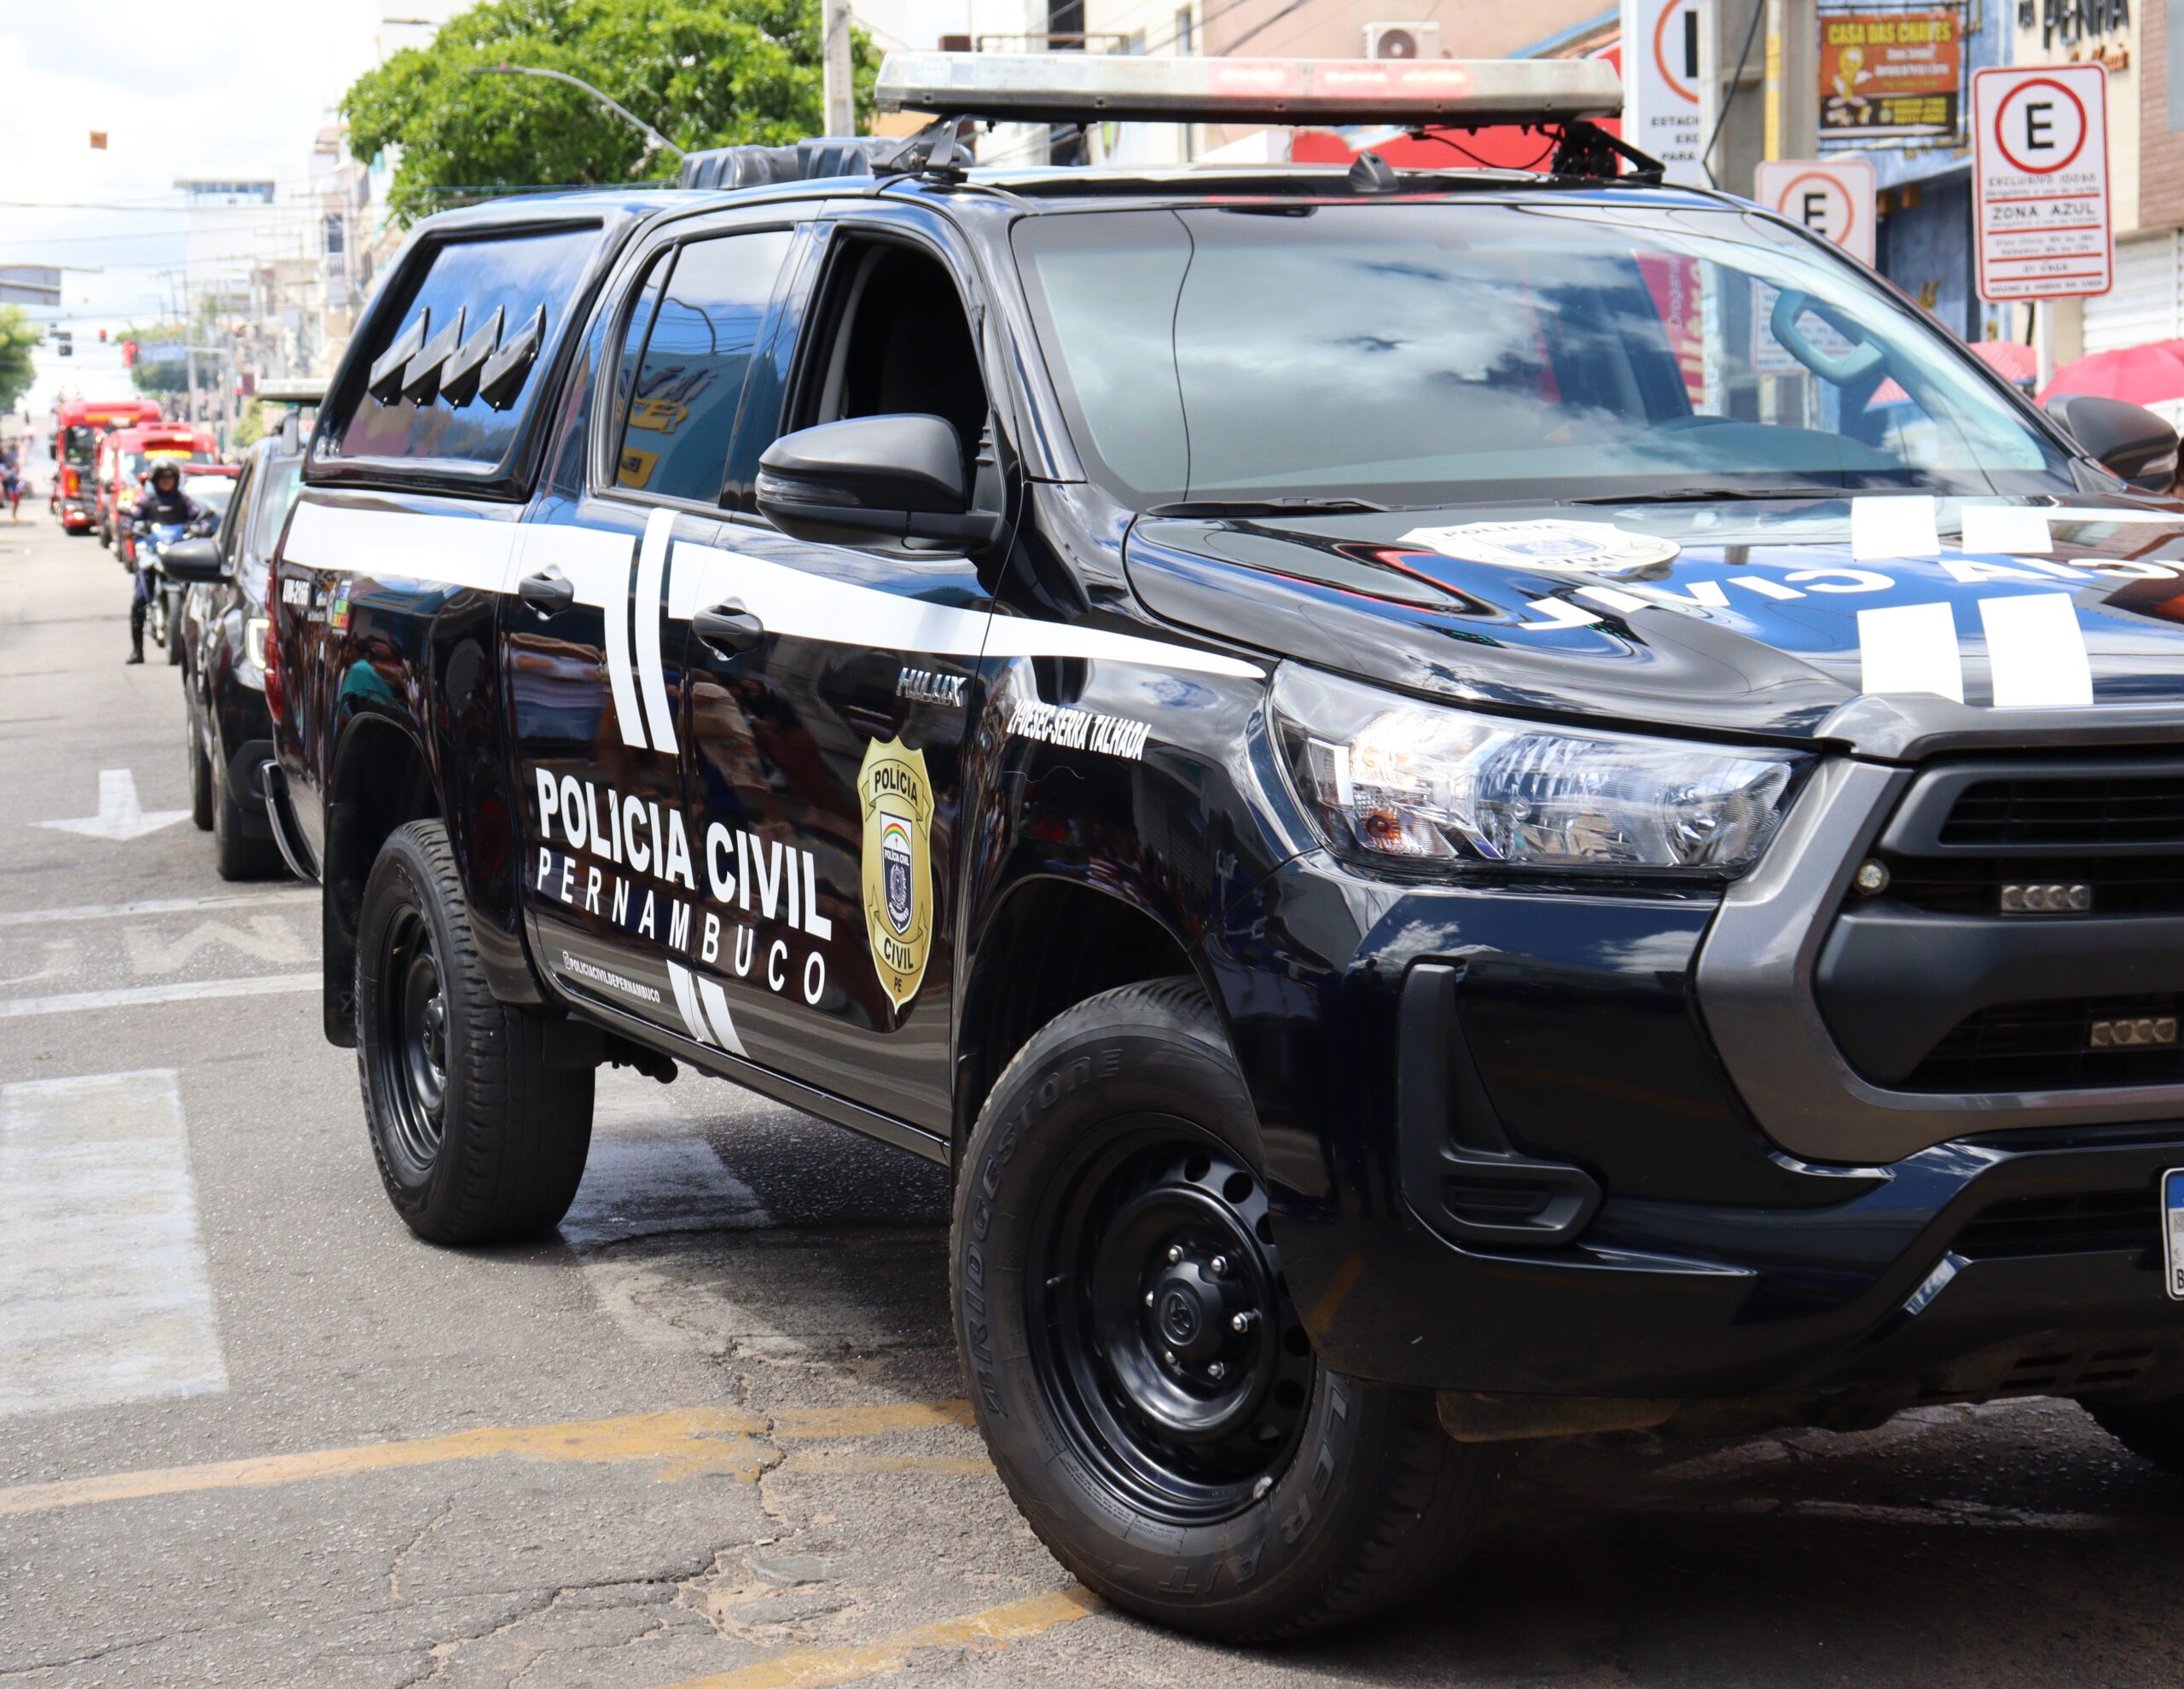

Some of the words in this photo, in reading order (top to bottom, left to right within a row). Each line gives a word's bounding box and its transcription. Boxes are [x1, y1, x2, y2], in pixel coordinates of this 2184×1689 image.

[2026, 102, 2054, 149] E
[1804, 193, 1827, 234] E
[1993, 206, 2038, 219] ZONA
[2051, 202, 2095, 216] AZUL
[896, 667, 967, 707] HILUX
[1089, 714, 1152, 761] TALHADA
[874, 764, 919, 807] POLÍCIA
[706, 821, 833, 942] CIVIL
[537, 846, 826, 1005] PERNAMBUCO
[884, 937, 914, 970] CIVIL
[563, 950, 661, 1004] @POLICIACIVILDEPERNAMBUCO
[893, 976, 903, 993] PE
